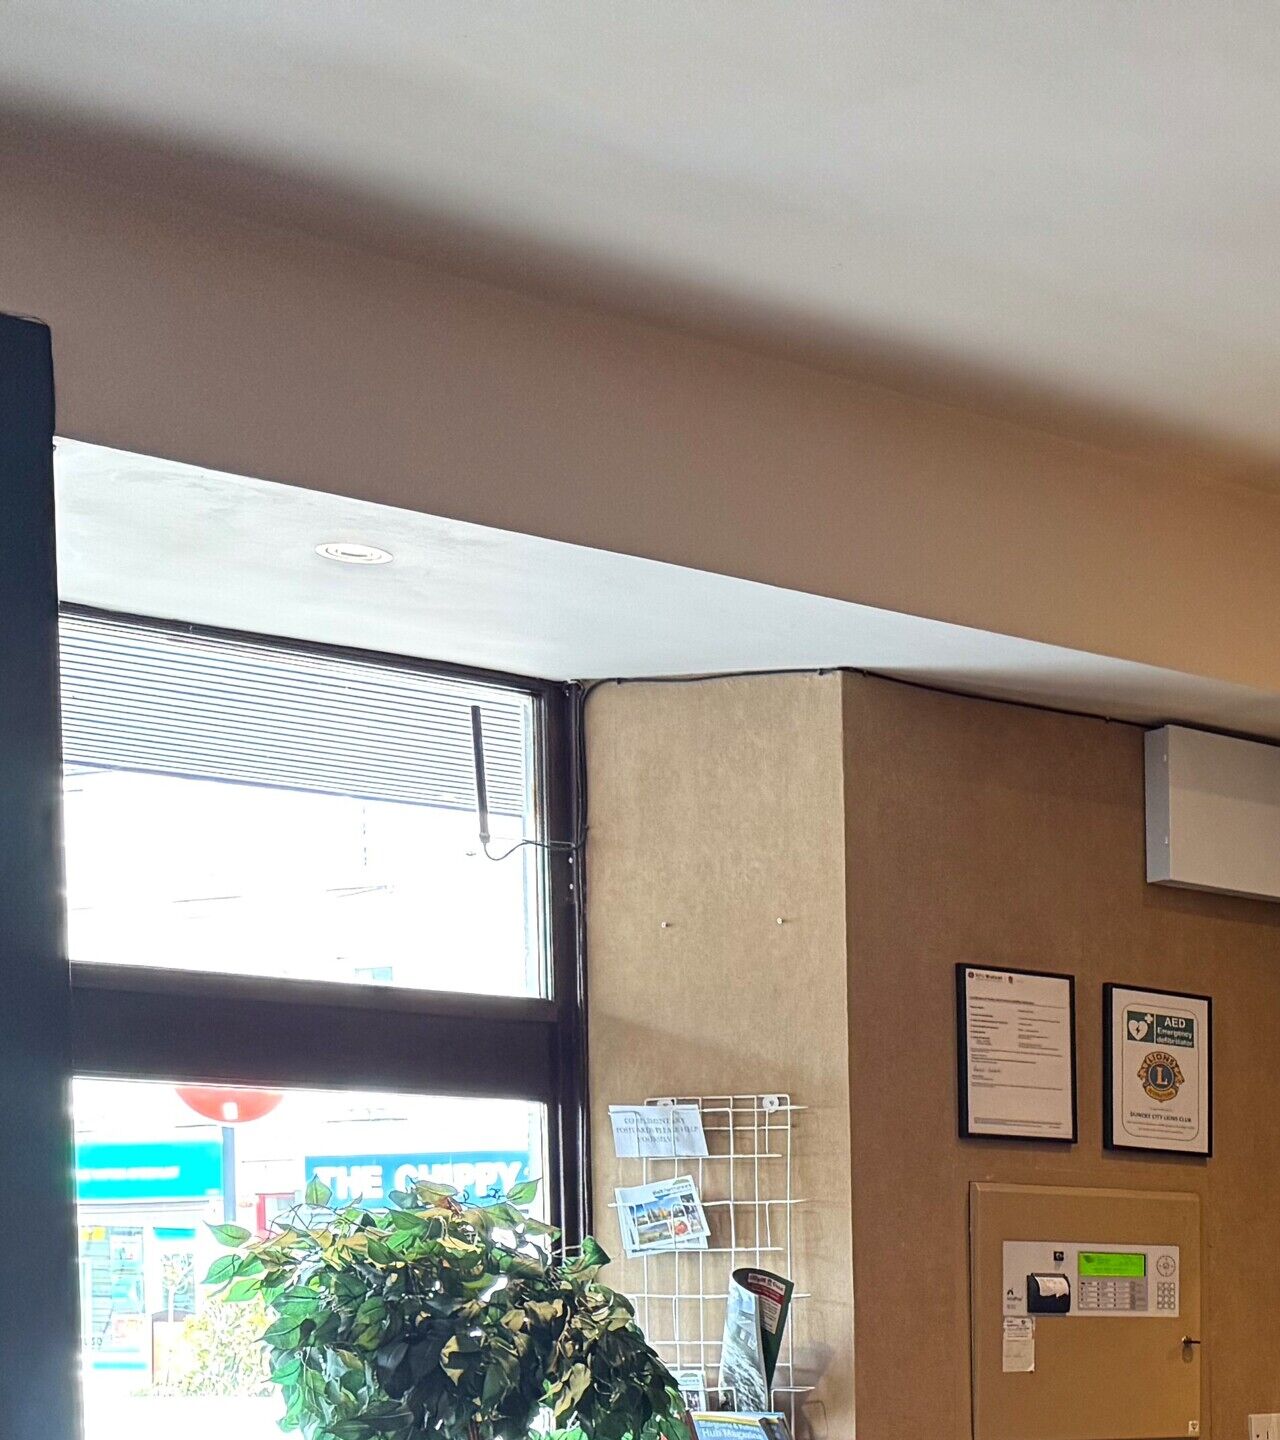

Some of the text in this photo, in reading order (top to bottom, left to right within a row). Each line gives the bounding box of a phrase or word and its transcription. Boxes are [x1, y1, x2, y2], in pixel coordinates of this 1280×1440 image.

[1165, 1017, 1185, 1028] AED
[1157, 1027, 1192, 1038] Emergency
[1148, 1052, 1176, 1066] LIONS
[1156, 1067, 1167, 1085] L
[313, 1165, 383, 1200] THE
